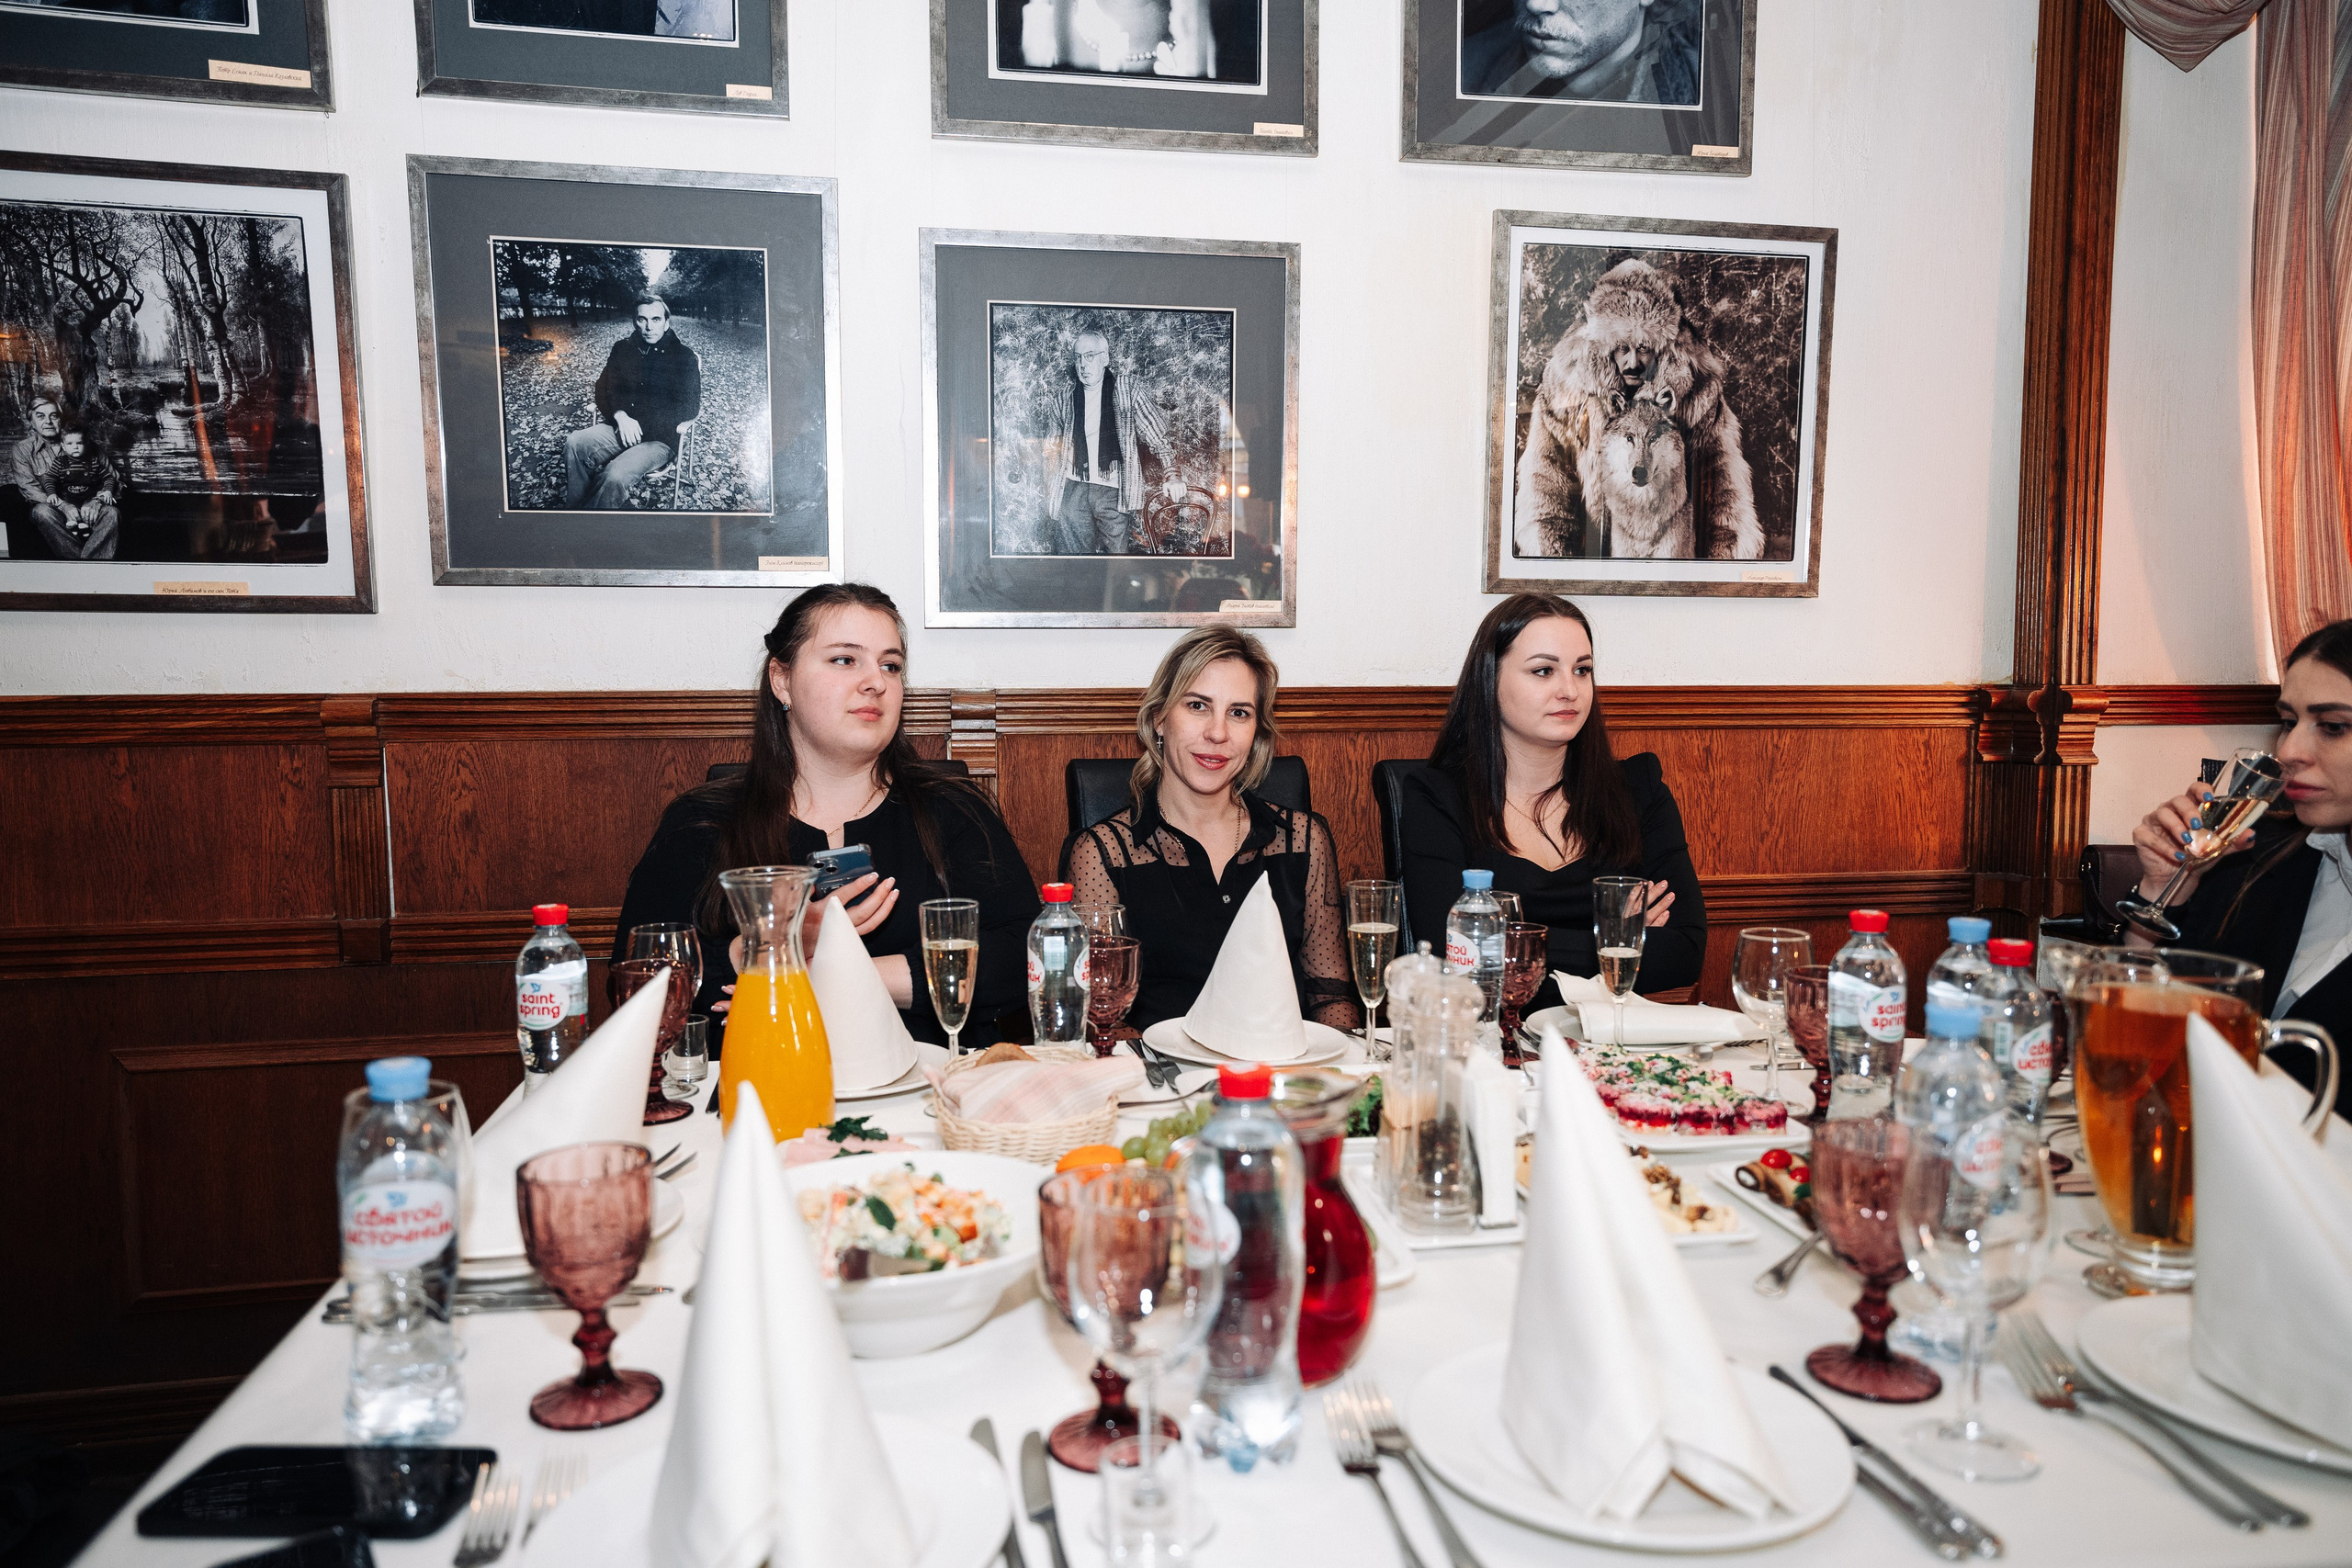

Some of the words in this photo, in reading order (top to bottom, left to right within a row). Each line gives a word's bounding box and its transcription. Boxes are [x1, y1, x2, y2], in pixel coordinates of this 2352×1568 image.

[522, 993, 555, 1004] saint
[519, 1004, 560, 1019] spring
[1871, 1015, 1906, 1031] sprin
